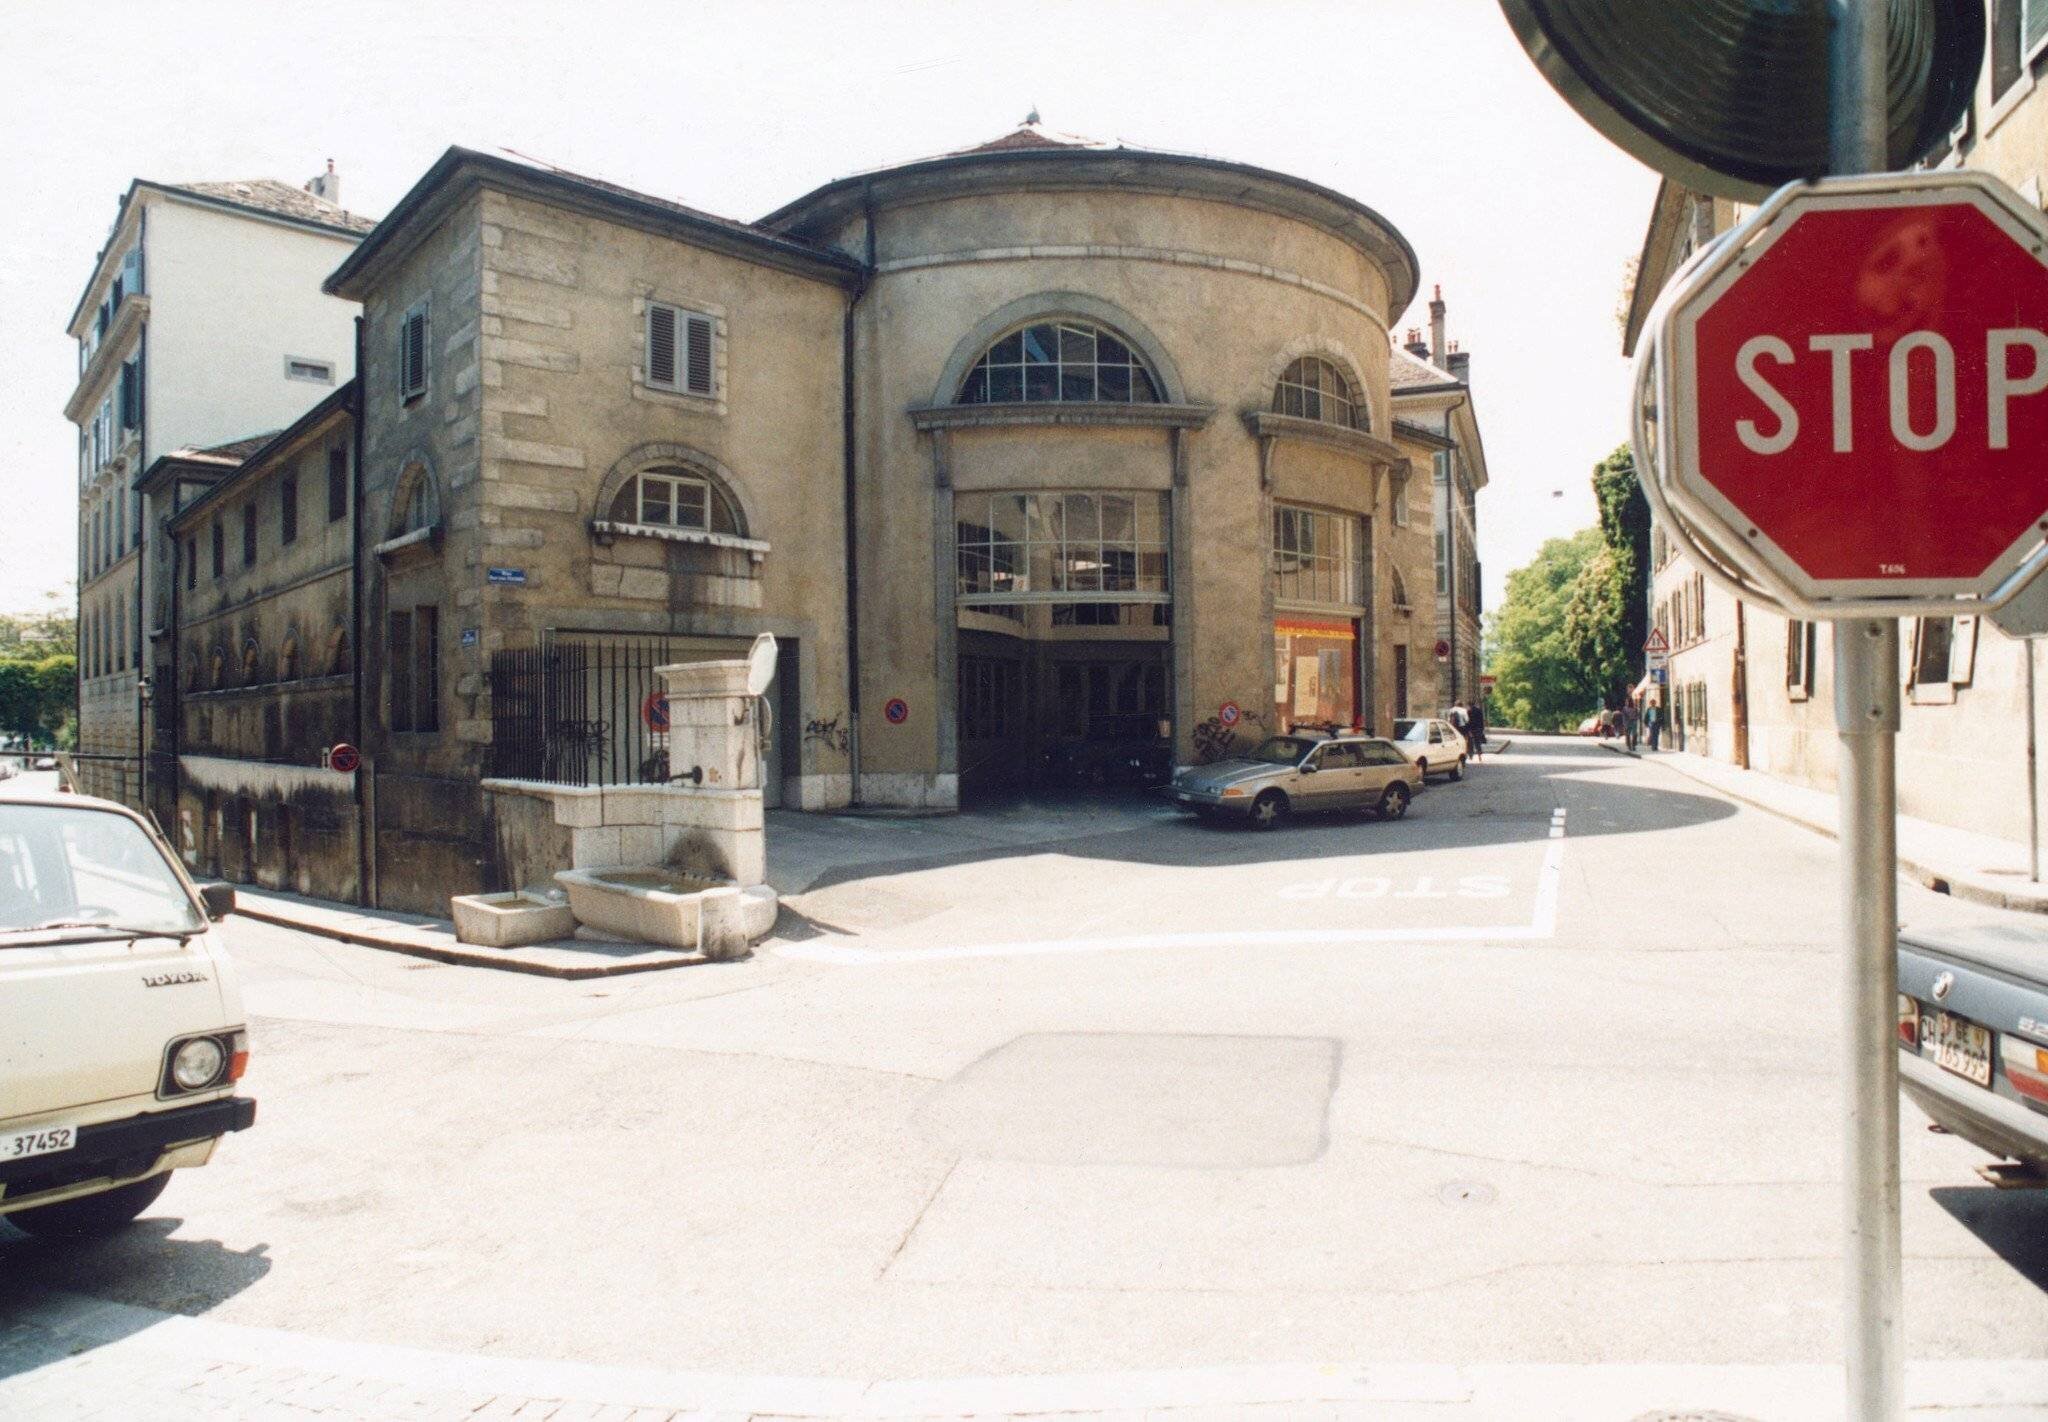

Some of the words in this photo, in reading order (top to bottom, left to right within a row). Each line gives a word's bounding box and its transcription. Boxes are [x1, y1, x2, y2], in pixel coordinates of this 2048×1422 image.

[1735, 328, 2048, 455] STOP
[1277, 875, 1511, 899] STOP
[13, 1129, 71, 1155] 37452
